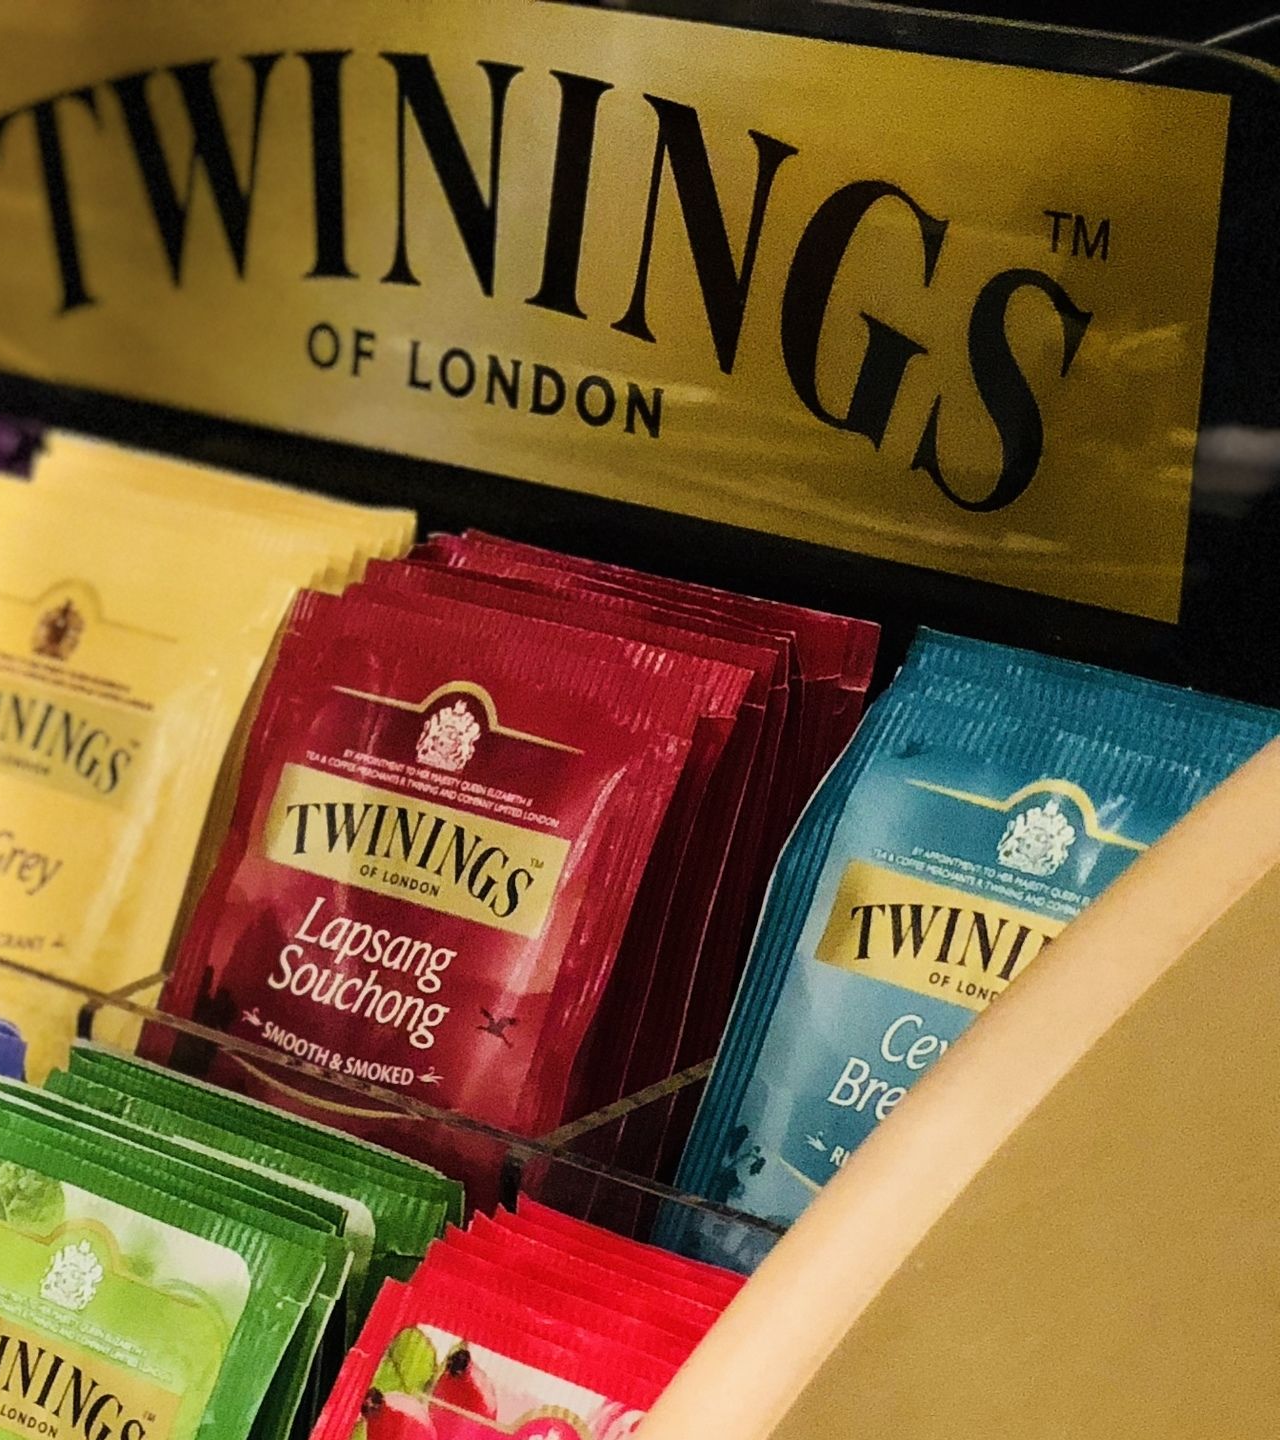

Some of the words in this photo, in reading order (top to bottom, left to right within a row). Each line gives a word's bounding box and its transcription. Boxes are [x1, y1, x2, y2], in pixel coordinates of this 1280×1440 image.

[1043, 208, 1113, 262] TM
[307, 321, 376, 378] OF
[407, 345, 663, 440] LONDON
[287, 802, 535, 919] TWININGS
[360, 864, 378, 879] OF
[382, 867, 440, 898] LONDON
[295, 896, 458, 992] Lapsang
[850, 904, 1052, 981] TWINI
[267, 945, 450, 1049] Souchong
[929, 972, 951, 987] OF
[262, 1021, 329, 1068] SMOOTH
[329, 1053, 342, 1070] &
[343, 1057, 414, 1086] SMOKED
[827, 1057, 907, 1120] Bre
[0, 1401, 58, 1440] LONDON
